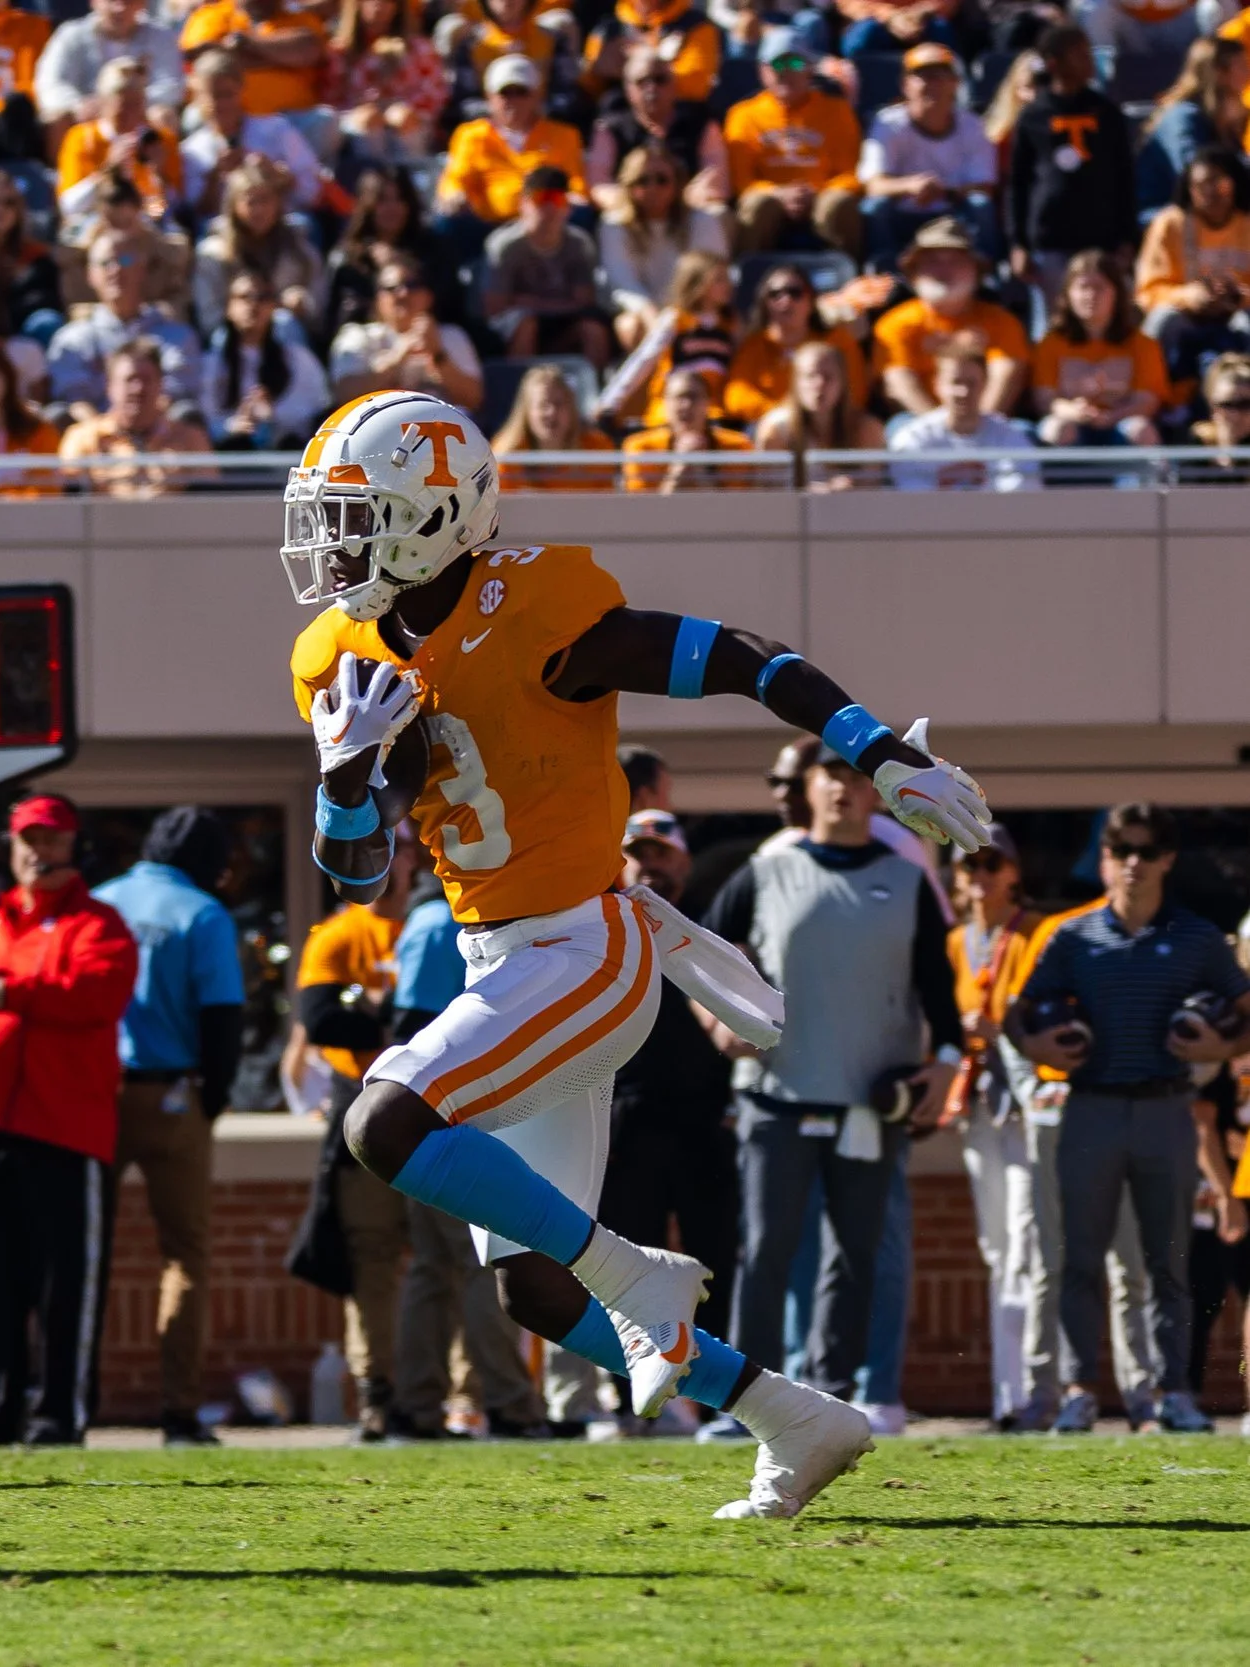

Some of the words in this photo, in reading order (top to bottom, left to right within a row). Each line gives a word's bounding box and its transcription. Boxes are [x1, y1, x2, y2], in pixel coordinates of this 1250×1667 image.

[1050, 115, 1098, 162] T
[400, 421, 466, 487] T
[479, 579, 505, 615] SEC
[426, 711, 512, 871] 3
